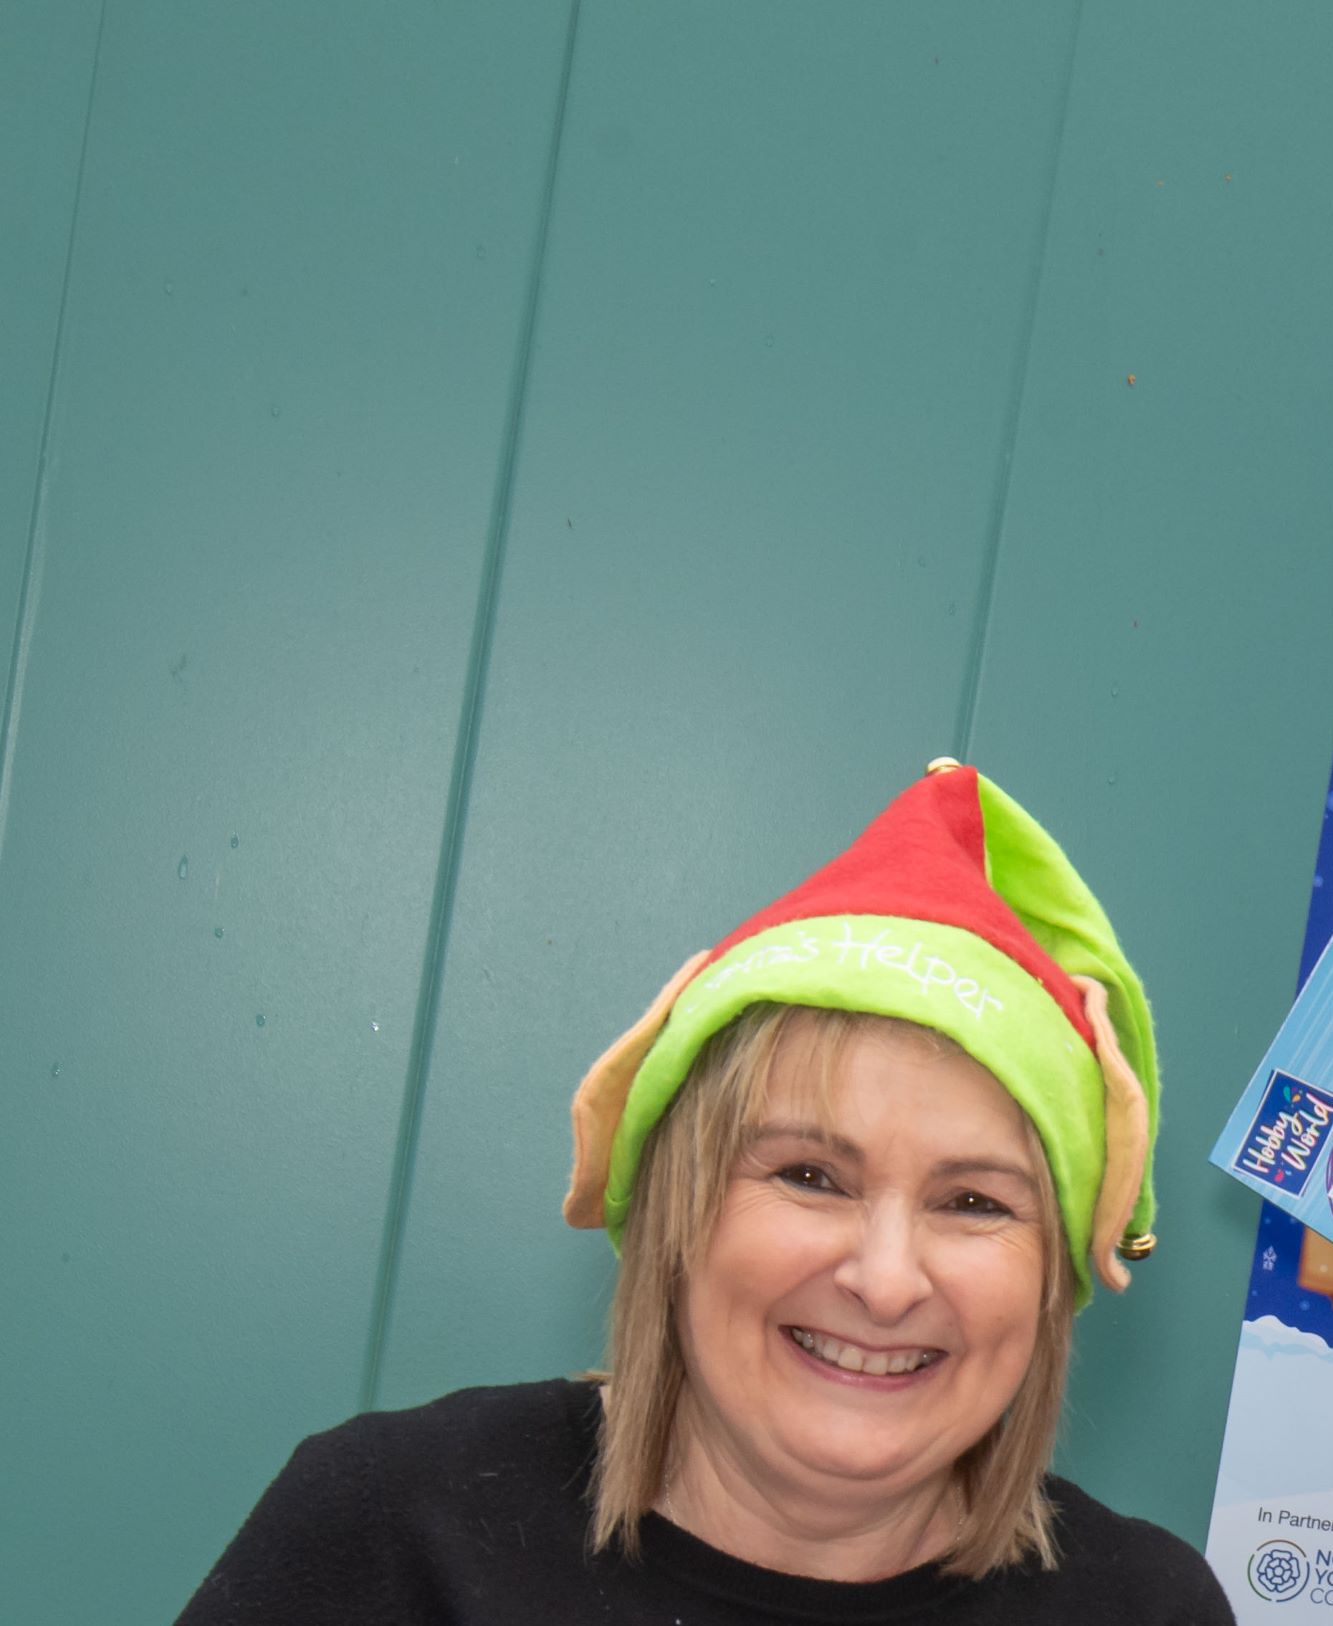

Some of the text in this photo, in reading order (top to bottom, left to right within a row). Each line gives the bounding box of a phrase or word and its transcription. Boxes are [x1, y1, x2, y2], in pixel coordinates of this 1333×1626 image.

[832, 921, 1004, 1021] Helper
[1243, 1109, 1303, 1174] Hobby
[1257, 1506, 1272, 1522] In
